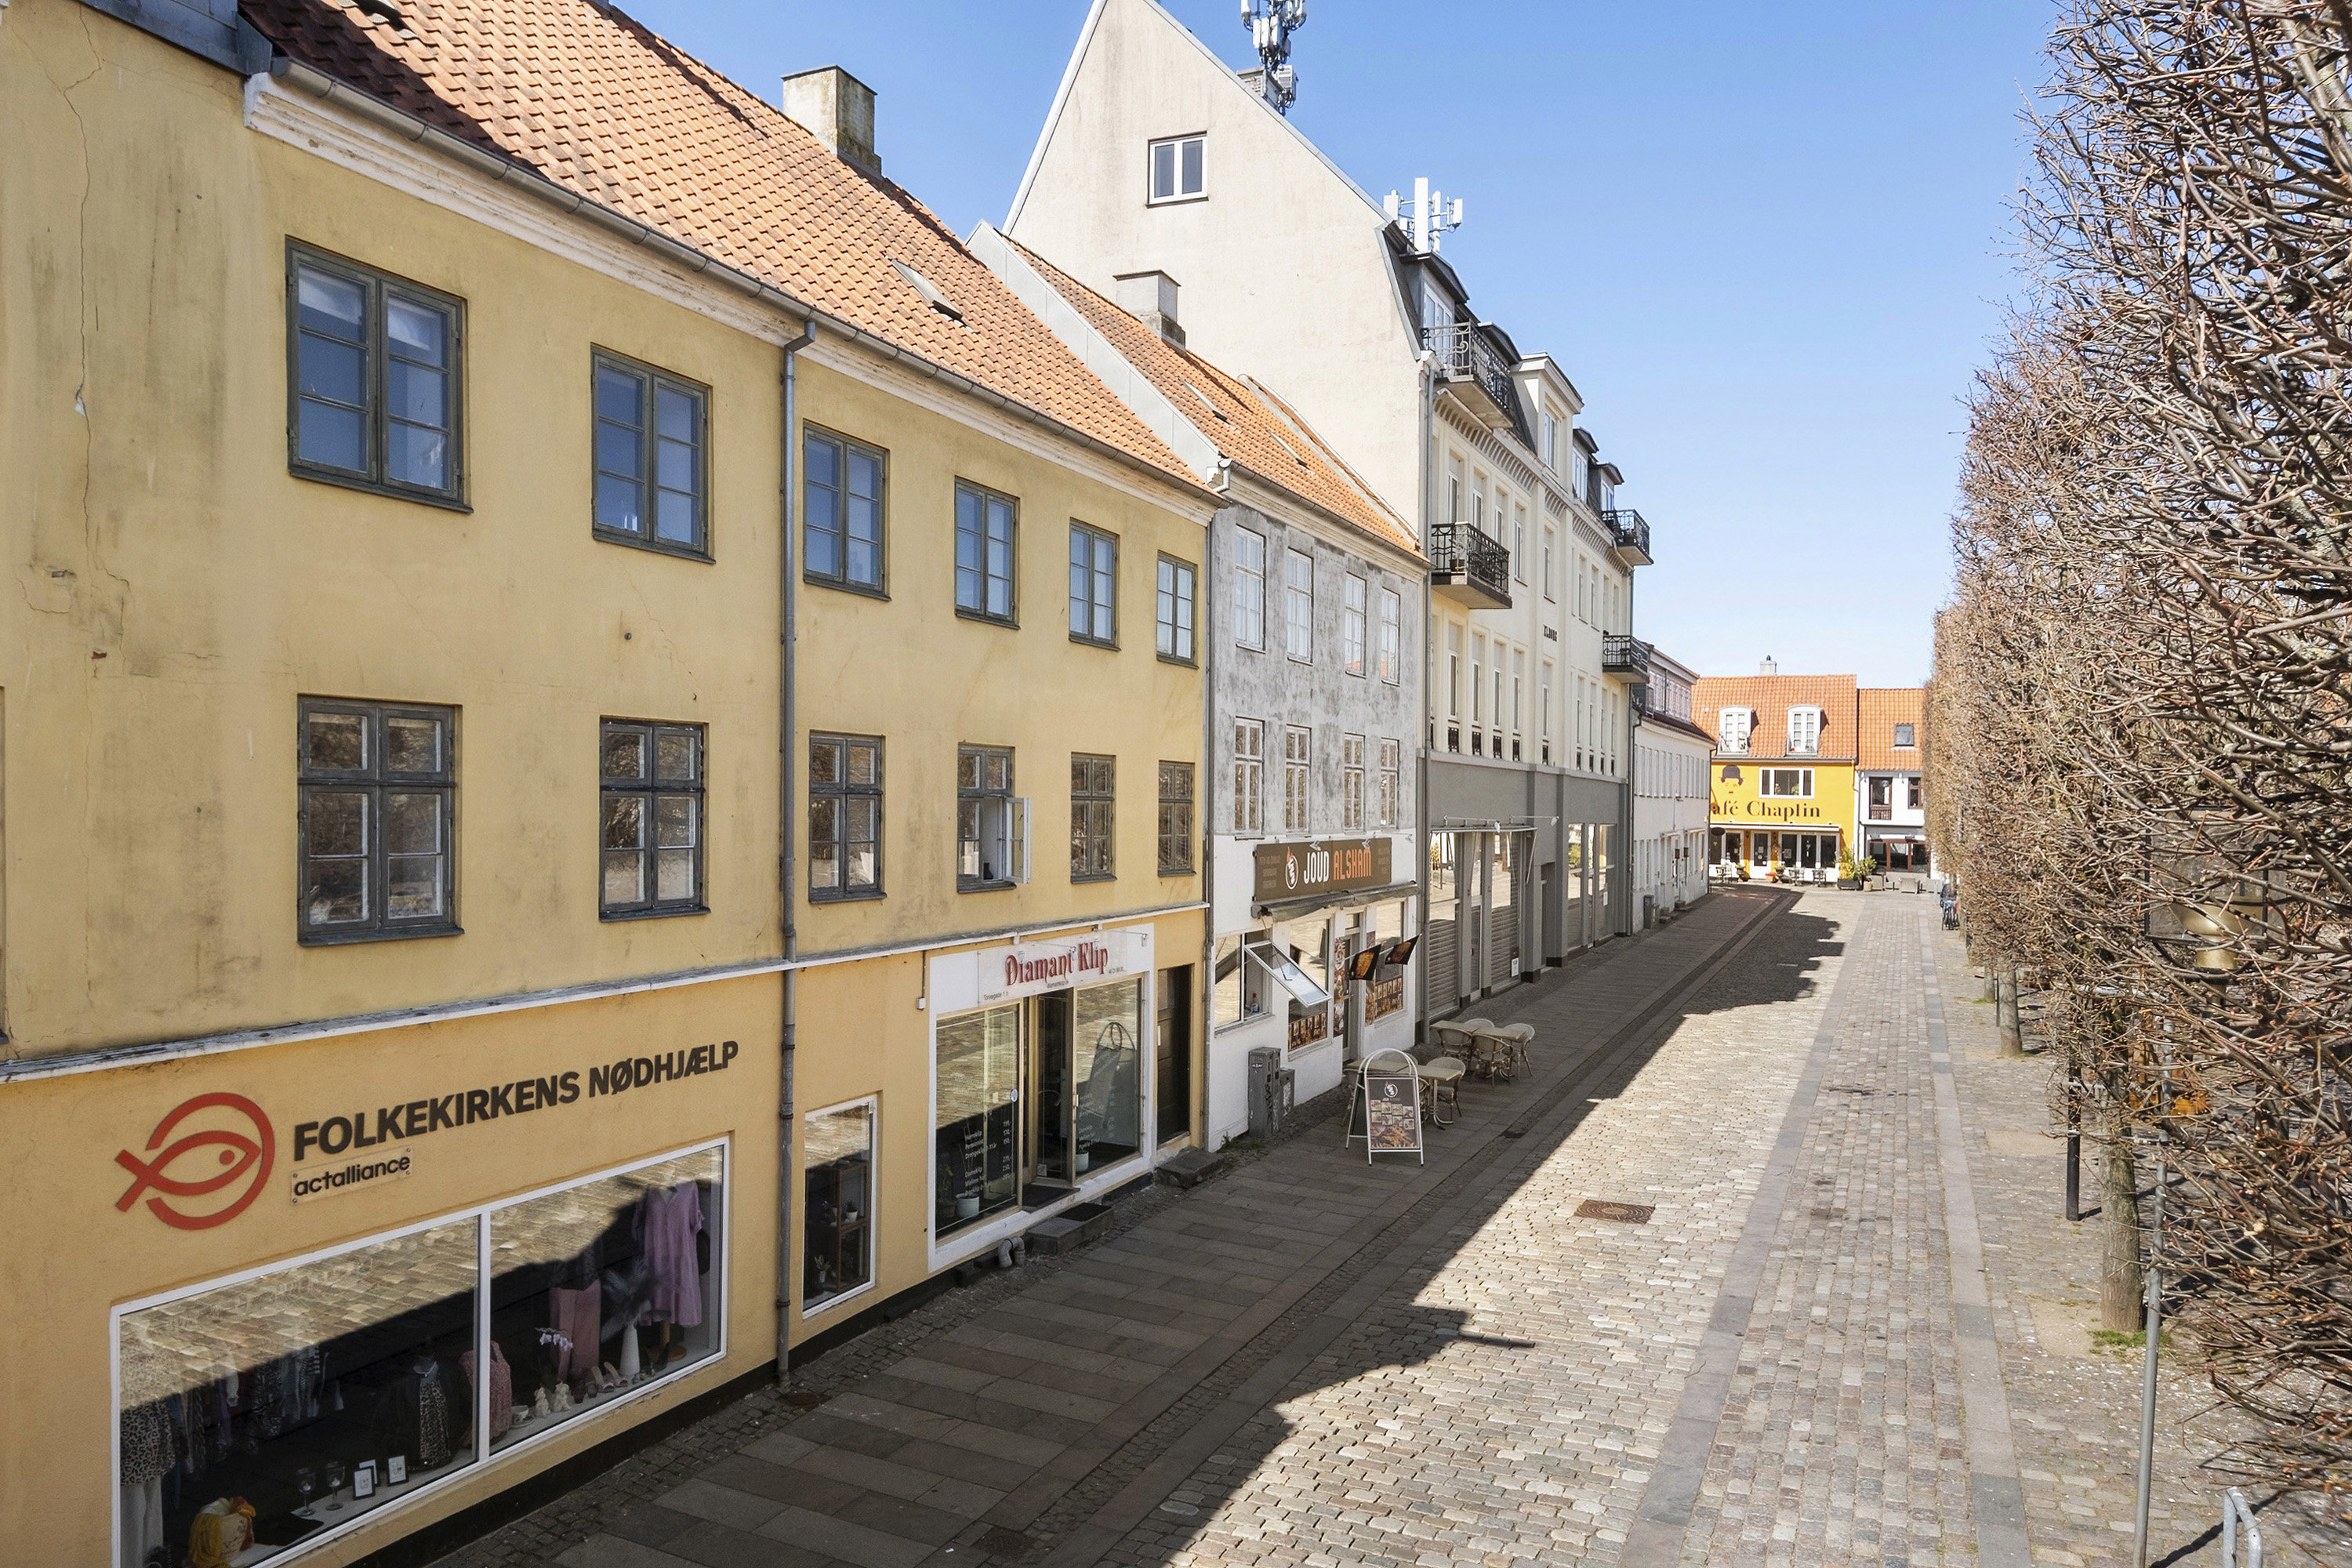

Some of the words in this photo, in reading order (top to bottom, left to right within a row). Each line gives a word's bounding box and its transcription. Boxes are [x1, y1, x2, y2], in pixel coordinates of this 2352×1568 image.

[1711, 800, 1739, 815] afé
[1747, 800, 1820, 822] Chaplin
[1303, 851, 1330, 884] JOUD
[1005, 951, 1073, 985] Diamant
[1079, 941, 1109, 975] Klip
[293, 1071, 580, 1162] FOLKEKIRKENS
[588, 1040, 739, 1098] NØDHJÆLP
[293, 1153, 411, 1196] actalliance
